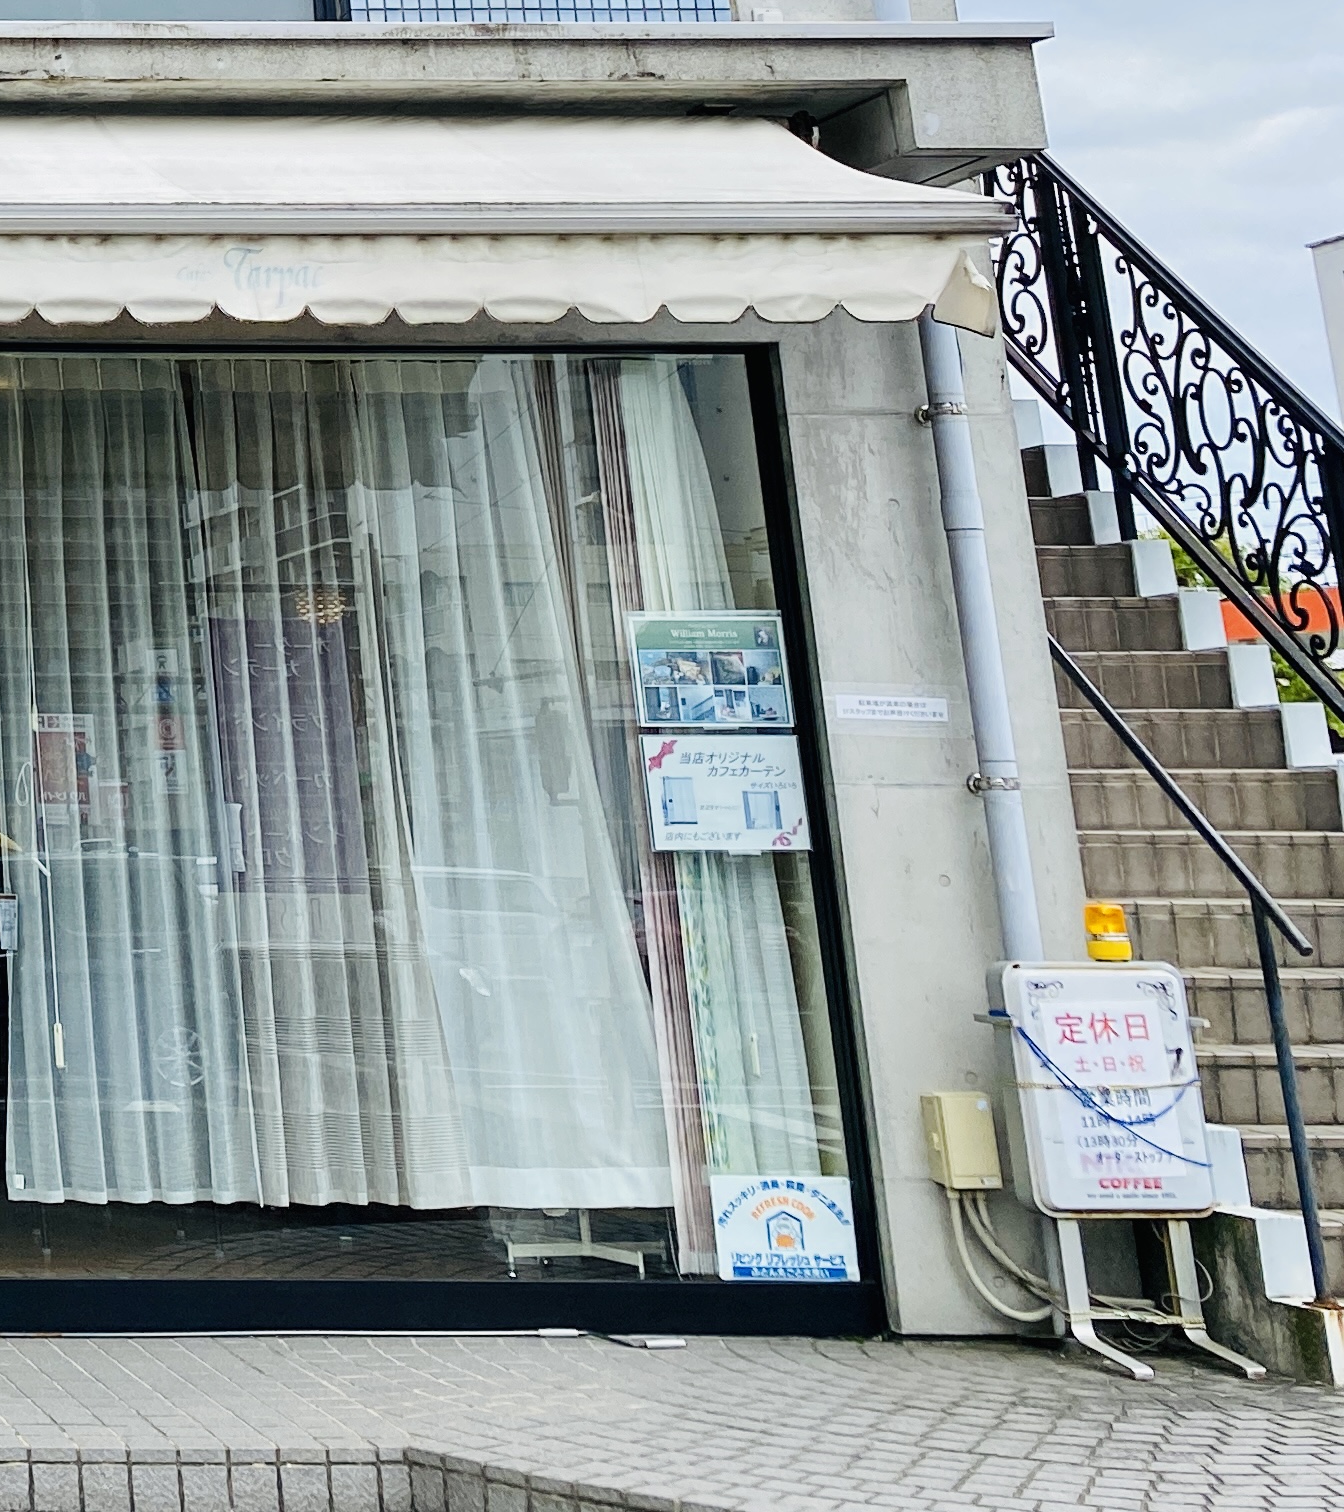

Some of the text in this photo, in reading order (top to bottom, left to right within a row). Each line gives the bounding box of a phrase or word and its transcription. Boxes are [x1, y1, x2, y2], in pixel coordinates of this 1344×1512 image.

[670, 629, 738, 638] William Morris
[679, 752, 766, 765] 当店オリジナル
[707, 765, 787, 778] カフェカーテン
[1055, 1012, 1149, 1045] 定休日
[1098, 1177, 1163, 1190] COFFEE
